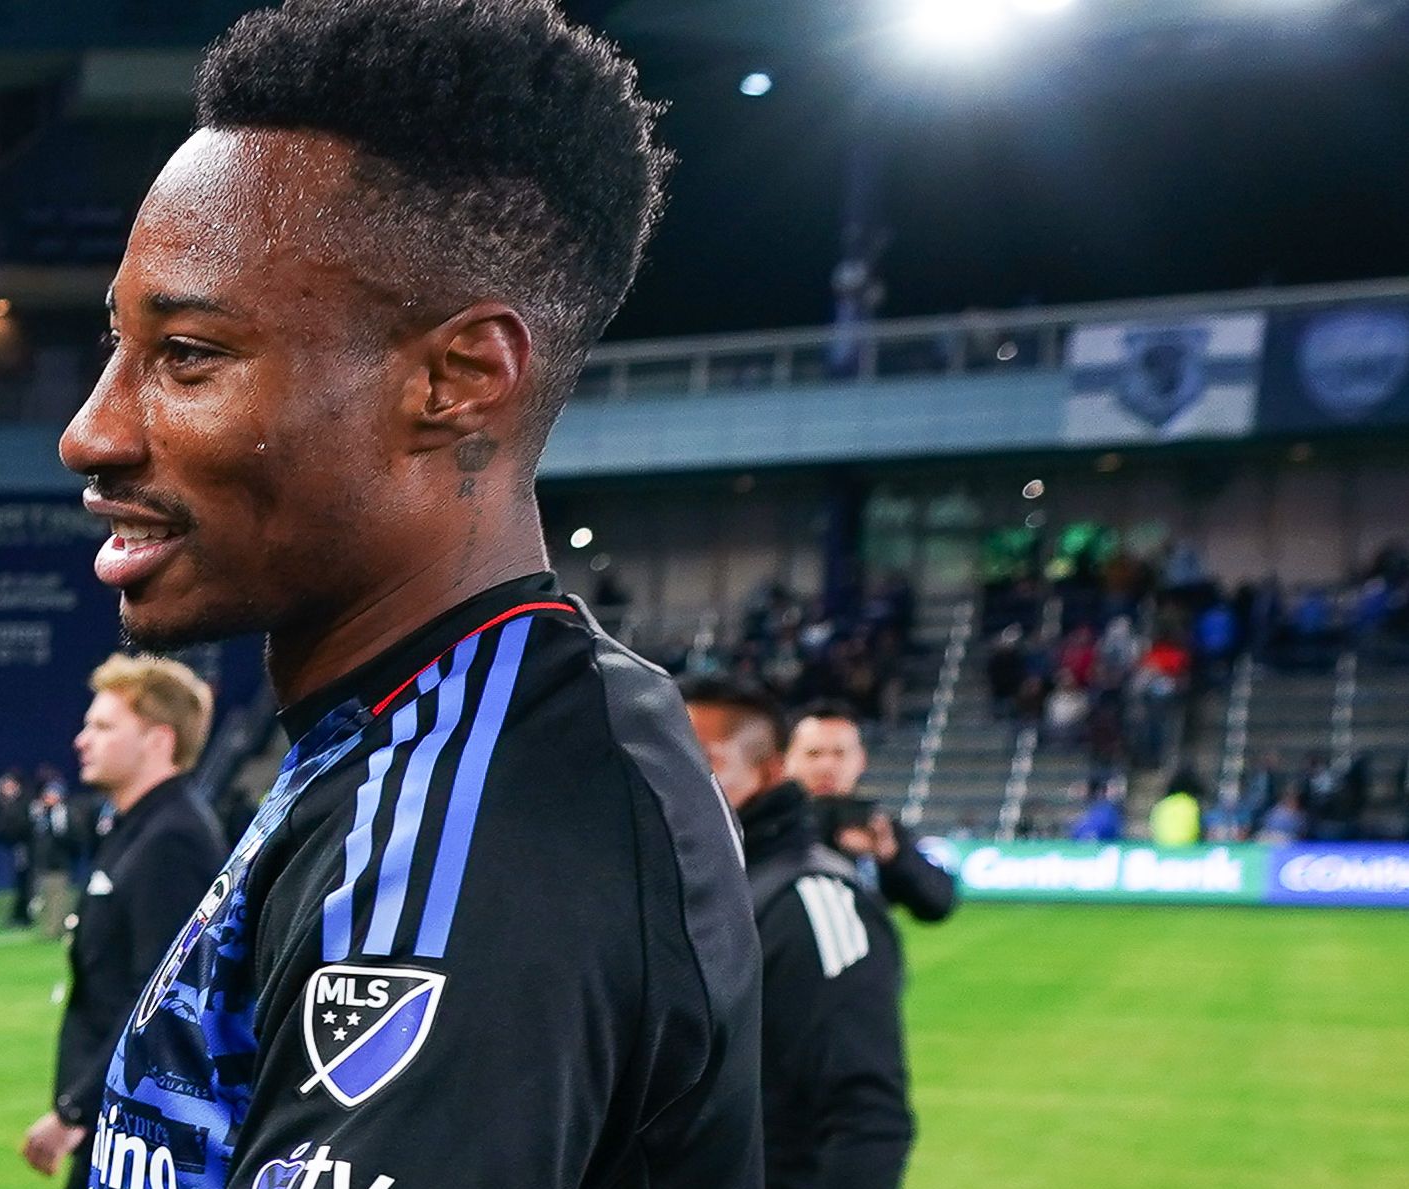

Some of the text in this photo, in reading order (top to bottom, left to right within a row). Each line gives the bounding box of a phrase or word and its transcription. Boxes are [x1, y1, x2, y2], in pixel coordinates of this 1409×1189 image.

[961, 846, 1243, 892] Central Bank
[315, 974, 391, 1009] MLS
